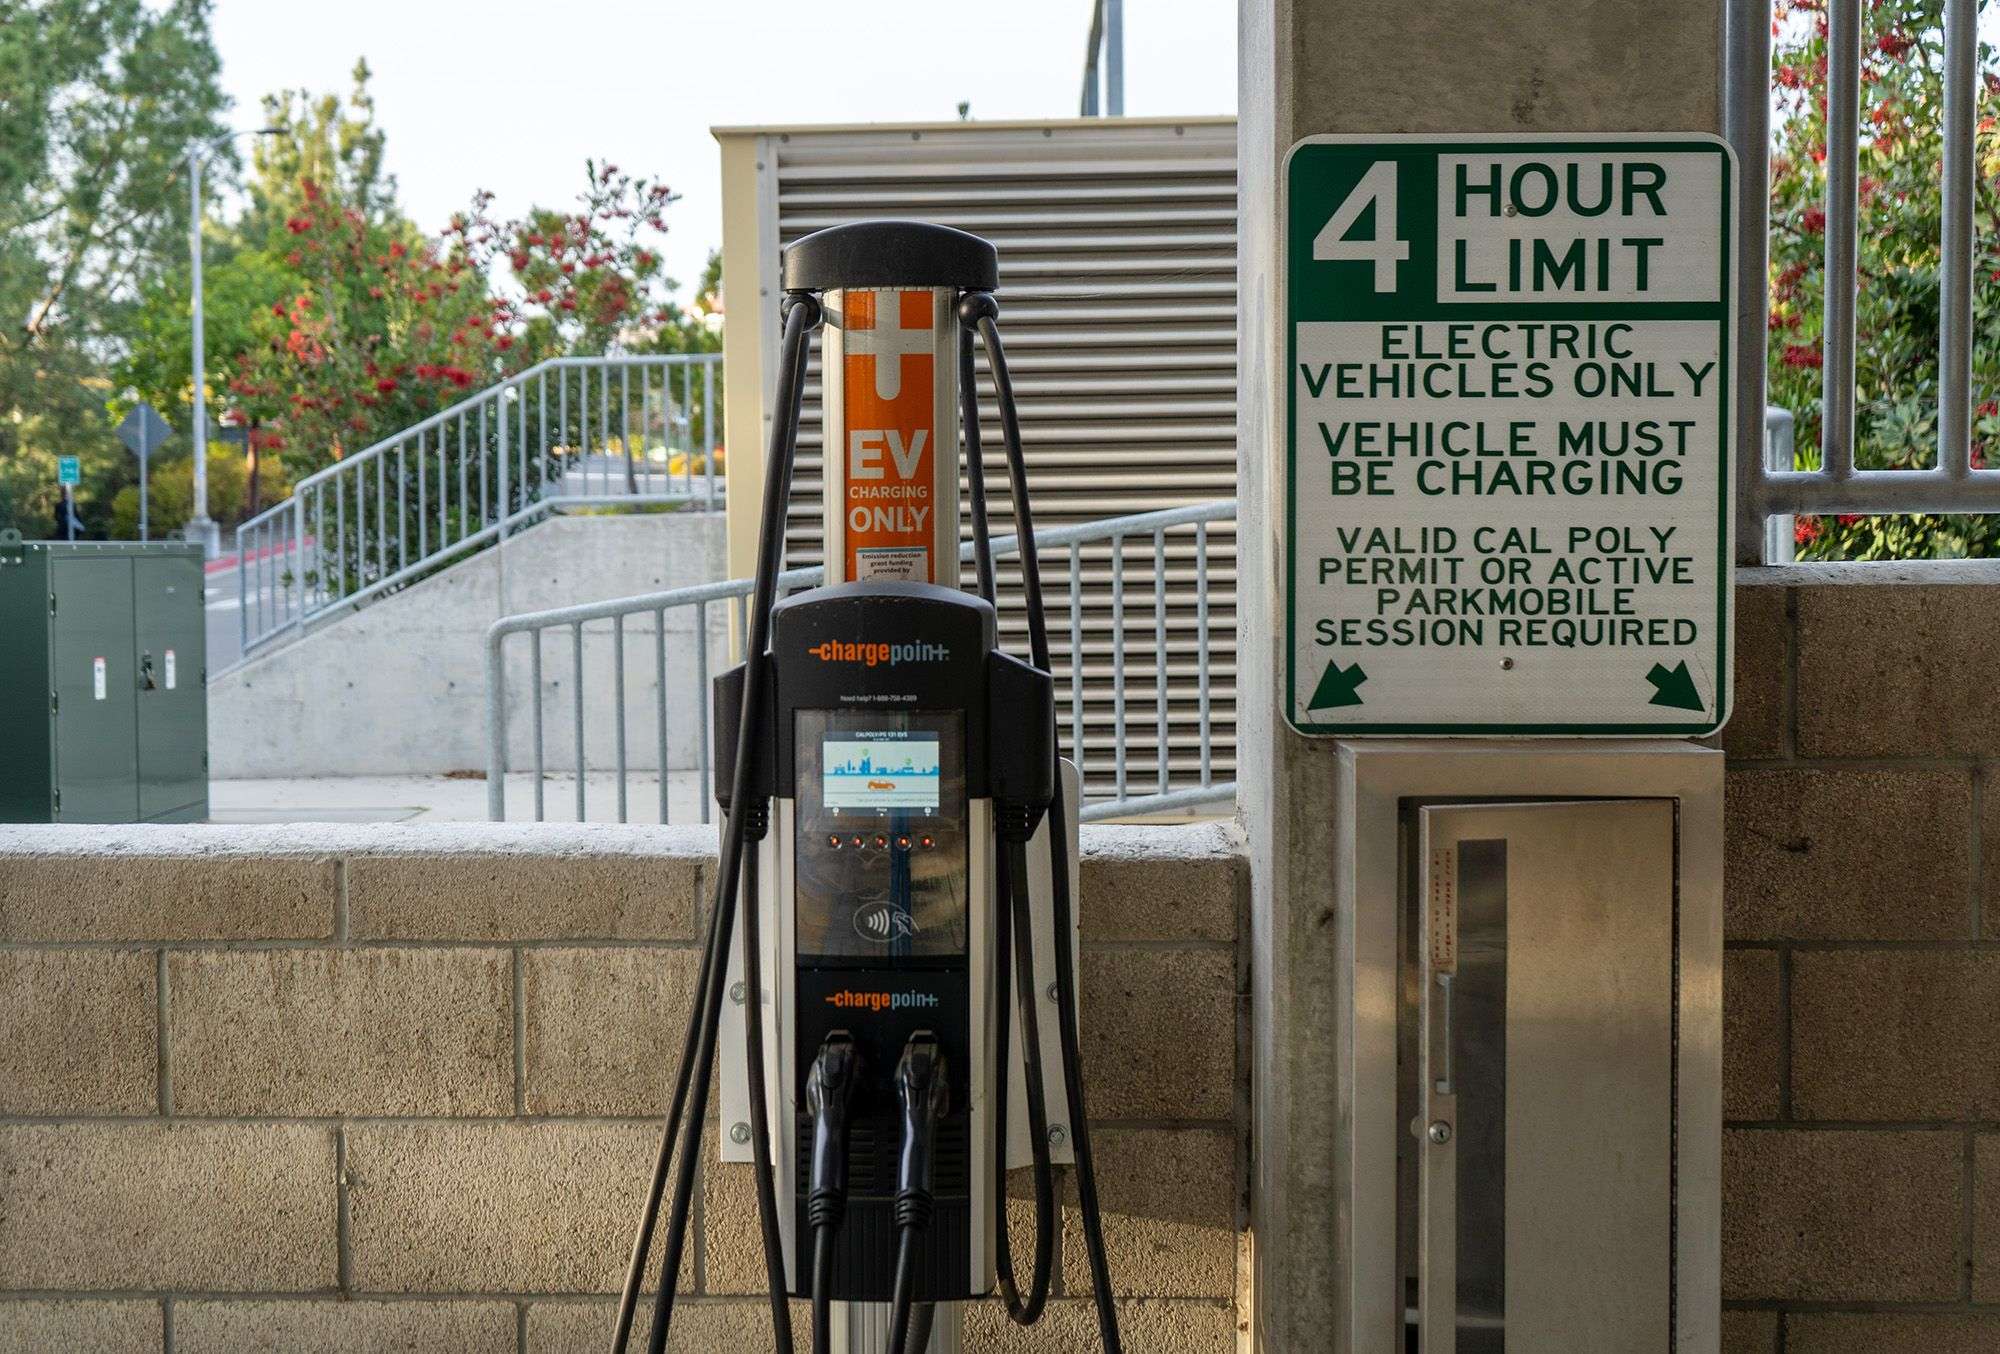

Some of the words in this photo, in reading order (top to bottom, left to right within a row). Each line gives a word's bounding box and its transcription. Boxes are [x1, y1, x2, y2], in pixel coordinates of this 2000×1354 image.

[1455, 163, 1667, 217] HOUR
[1313, 161, 1410, 293] 4
[1455, 238, 1664, 293] LIMIT
[1382, 324, 1634, 359] ELECTRIC
[1300, 363, 1554, 399] VEHICLES
[1575, 361, 1716, 398] ONLY
[849, 429, 929, 480] EV
[1318, 422, 1537, 457] VEHICLE
[1559, 420, 1696, 457] MUST
[849, 486, 928, 499] CHARGING
[1331, 460, 1395, 496] BE
[1416, 459, 1683, 496] CHARGING
[849, 506, 929, 533] ONLY
[1337, 527, 1457, 554] VALID
[1474, 527, 1552, 554] CAL
[1569, 526, 1677, 554] POLY
[873, 567, 901, 575] provided
[1320, 558, 1465, 585] PERMIT
[1480, 557, 1532, 585] OR
[1548, 557, 1694, 584] ACTIVE
[1377, 588, 1636, 616] PARKMOBILE
[1315, 619, 1482, 646] SESSION
[1499, 618, 1698, 649] REQUIRED
